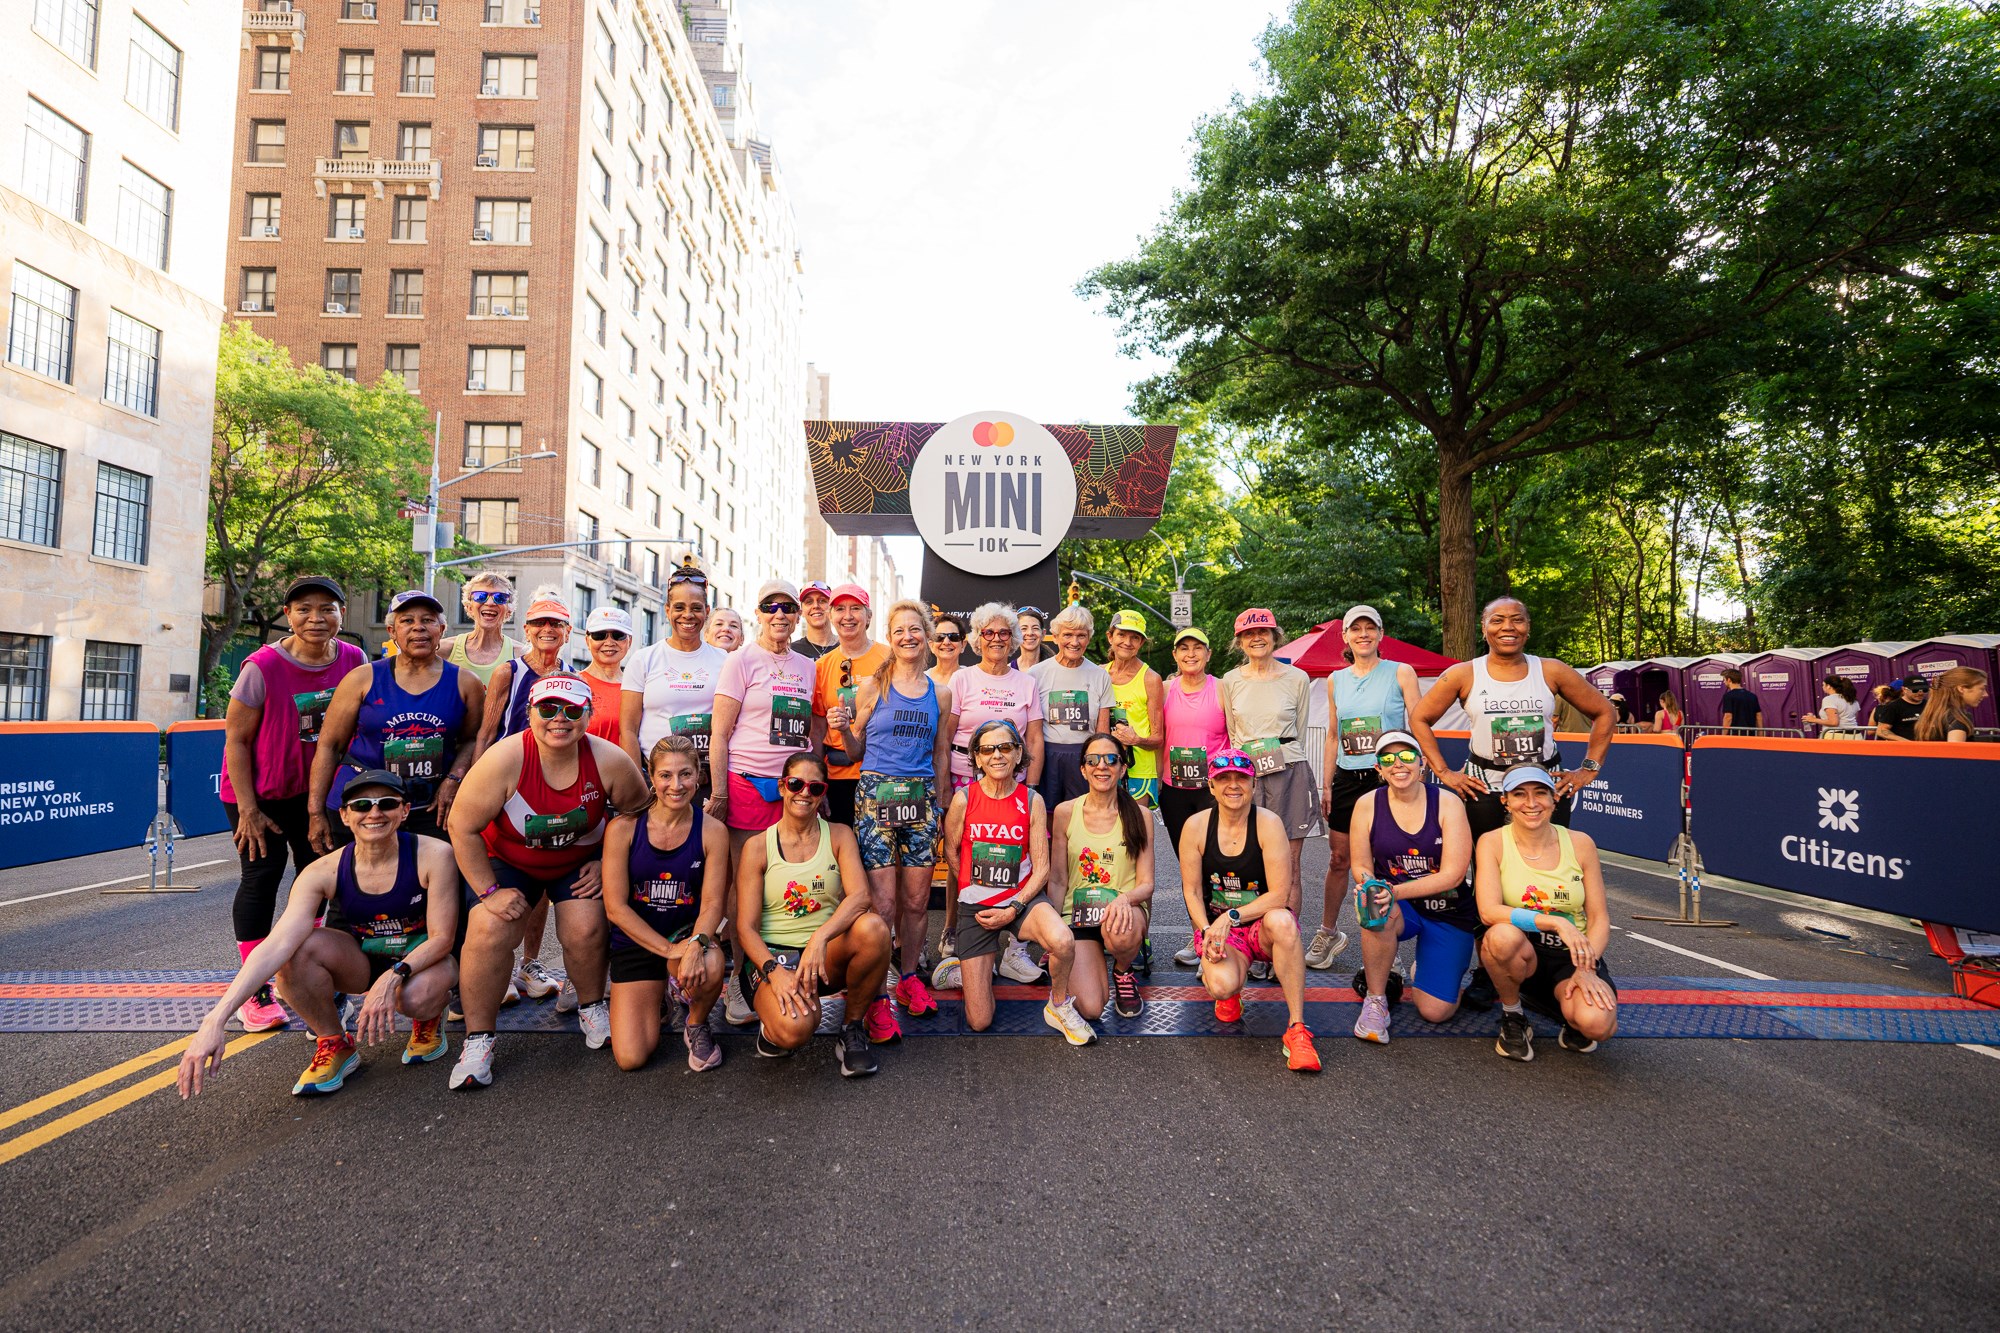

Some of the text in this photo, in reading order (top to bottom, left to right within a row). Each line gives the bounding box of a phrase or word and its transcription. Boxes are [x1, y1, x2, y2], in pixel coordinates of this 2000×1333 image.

[945, 454, 1042, 466] NEW YORK
[944, 471, 1042, 536] MINI
[979, 537, 1009, 552] 10K
[1174, 607, 1189, 616] 25
[1243, 614, 1268, 626] Mets
[546, 681, 573, 691] PPTC
[1484, 696, 1544, 711] taconic
[386, 711, 445, 728] MERCURY
[893, 708, 929, 726] moving
[1064, 707, 1081, 720] 136
[788, 719, 805, 734] 106
[893, 724, 932, 740] comfort
[692, 734, 709, 749] 132
[1355, 736, 1374, 750] 122
[1514, 736, 1534, 752] 131
[408, 760, 432, 777] 148
[1257, 755, 1275, 771] 156
[1182, 765, 1200, 778] 105
[0, 780, 55, 795] RISING
[1585, 780, 1609, 790] SING
[0, 791, 82, 811] NEW YORK
[580, 790, 600, 804] PPTC
[1582, 789, 1623, 804] NEW YORK
[0, 802, 115, 826] ROAD RUNNERS
[896, 805, 918, 821] 100
[1582, 801, 1643, 820] ROAD RUNNERS
[969, 823, 1024, 841] NYAC
[1102, 852, 1115, 862] MINI
[1402, 858, 1428, 871] MINI
[1781, 835, 1904, 880] Citizens
[989, 867, 1011, 883] 140
[812, 882, 825, 890] MINI
[1223, 879, 1241, 889] MINI
[650, 884, 678, 900] MINI
[1554, 891, 1570, 901] MINI
[1424, 898, 1447, 911] 109
[1540, 932, 1563, 948] 153
